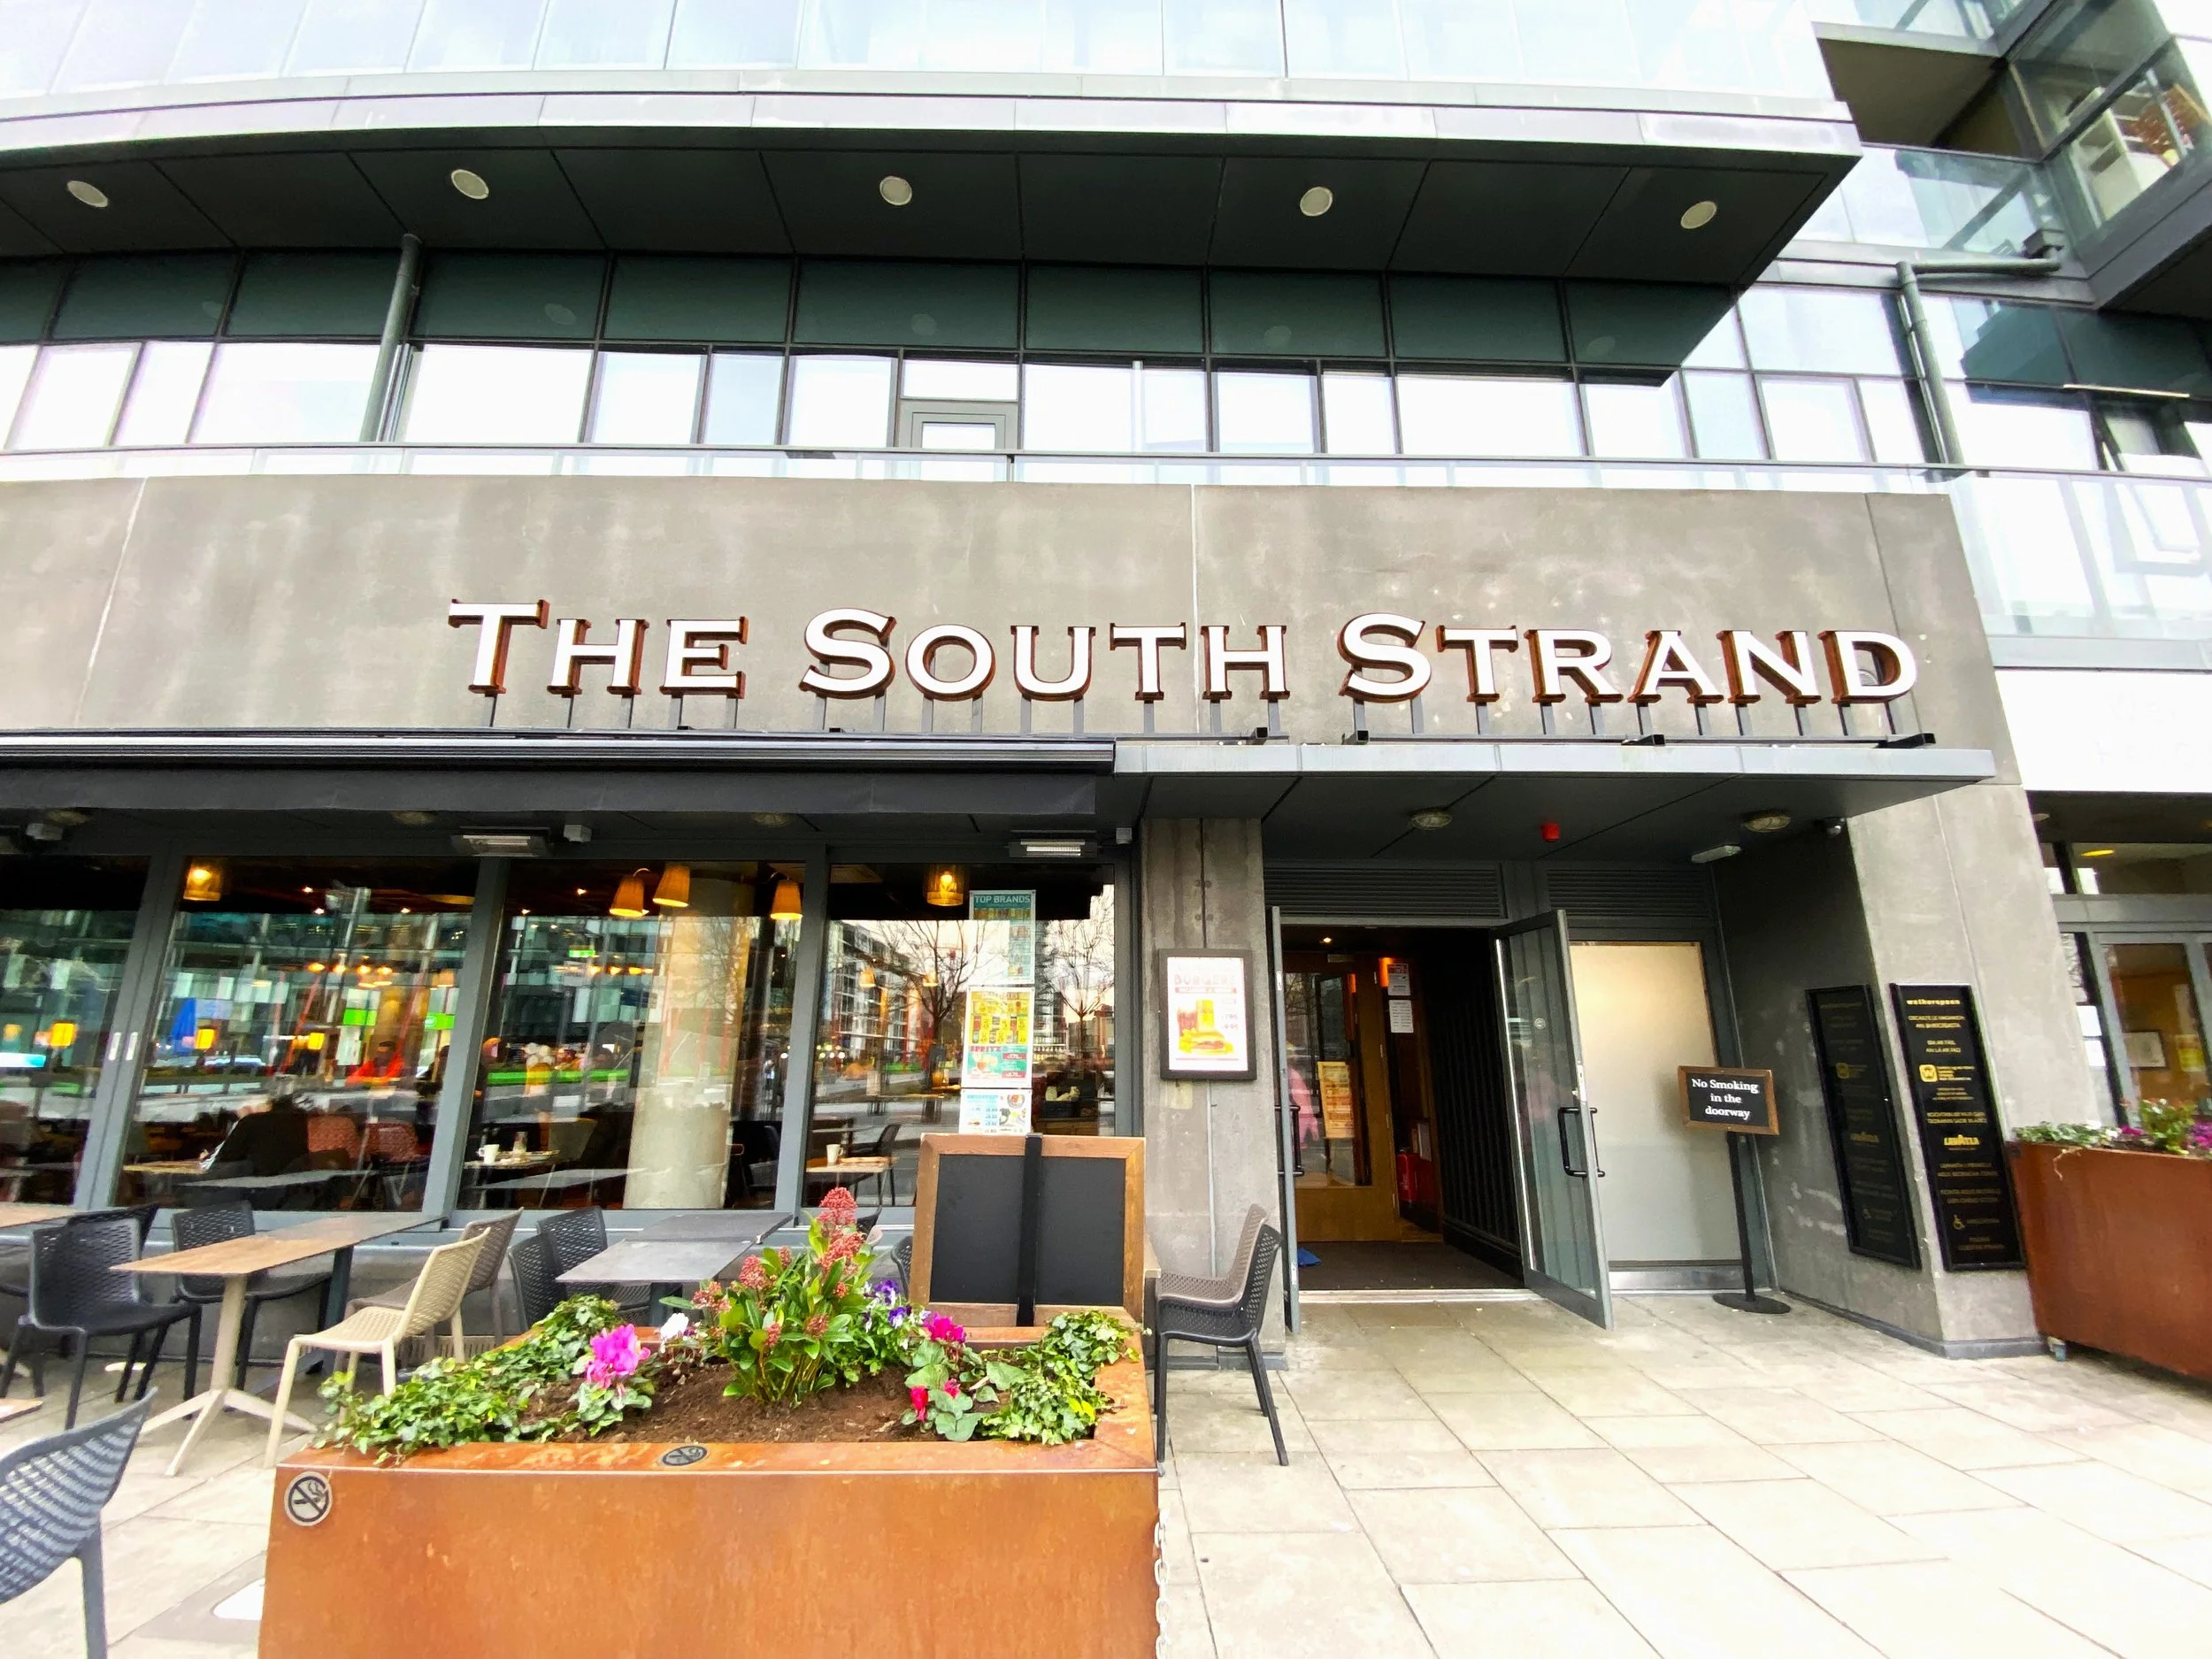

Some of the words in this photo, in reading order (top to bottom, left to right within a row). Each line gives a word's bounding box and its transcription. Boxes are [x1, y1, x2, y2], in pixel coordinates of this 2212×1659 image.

[448, 599, 749, 699] THE
[799, 607, 1291, 701] SOUTH
[1338, 612, 1917, 704] STRAND
[1691, 1079, 1708, 1088] No
[1709, 1079, 1759, 1094] Smoking
[1710, 1093, 1722, 1102] in
[1724, 1094, 1742, 1103] the
[1705, 1105, 1750, 1120] doorway
